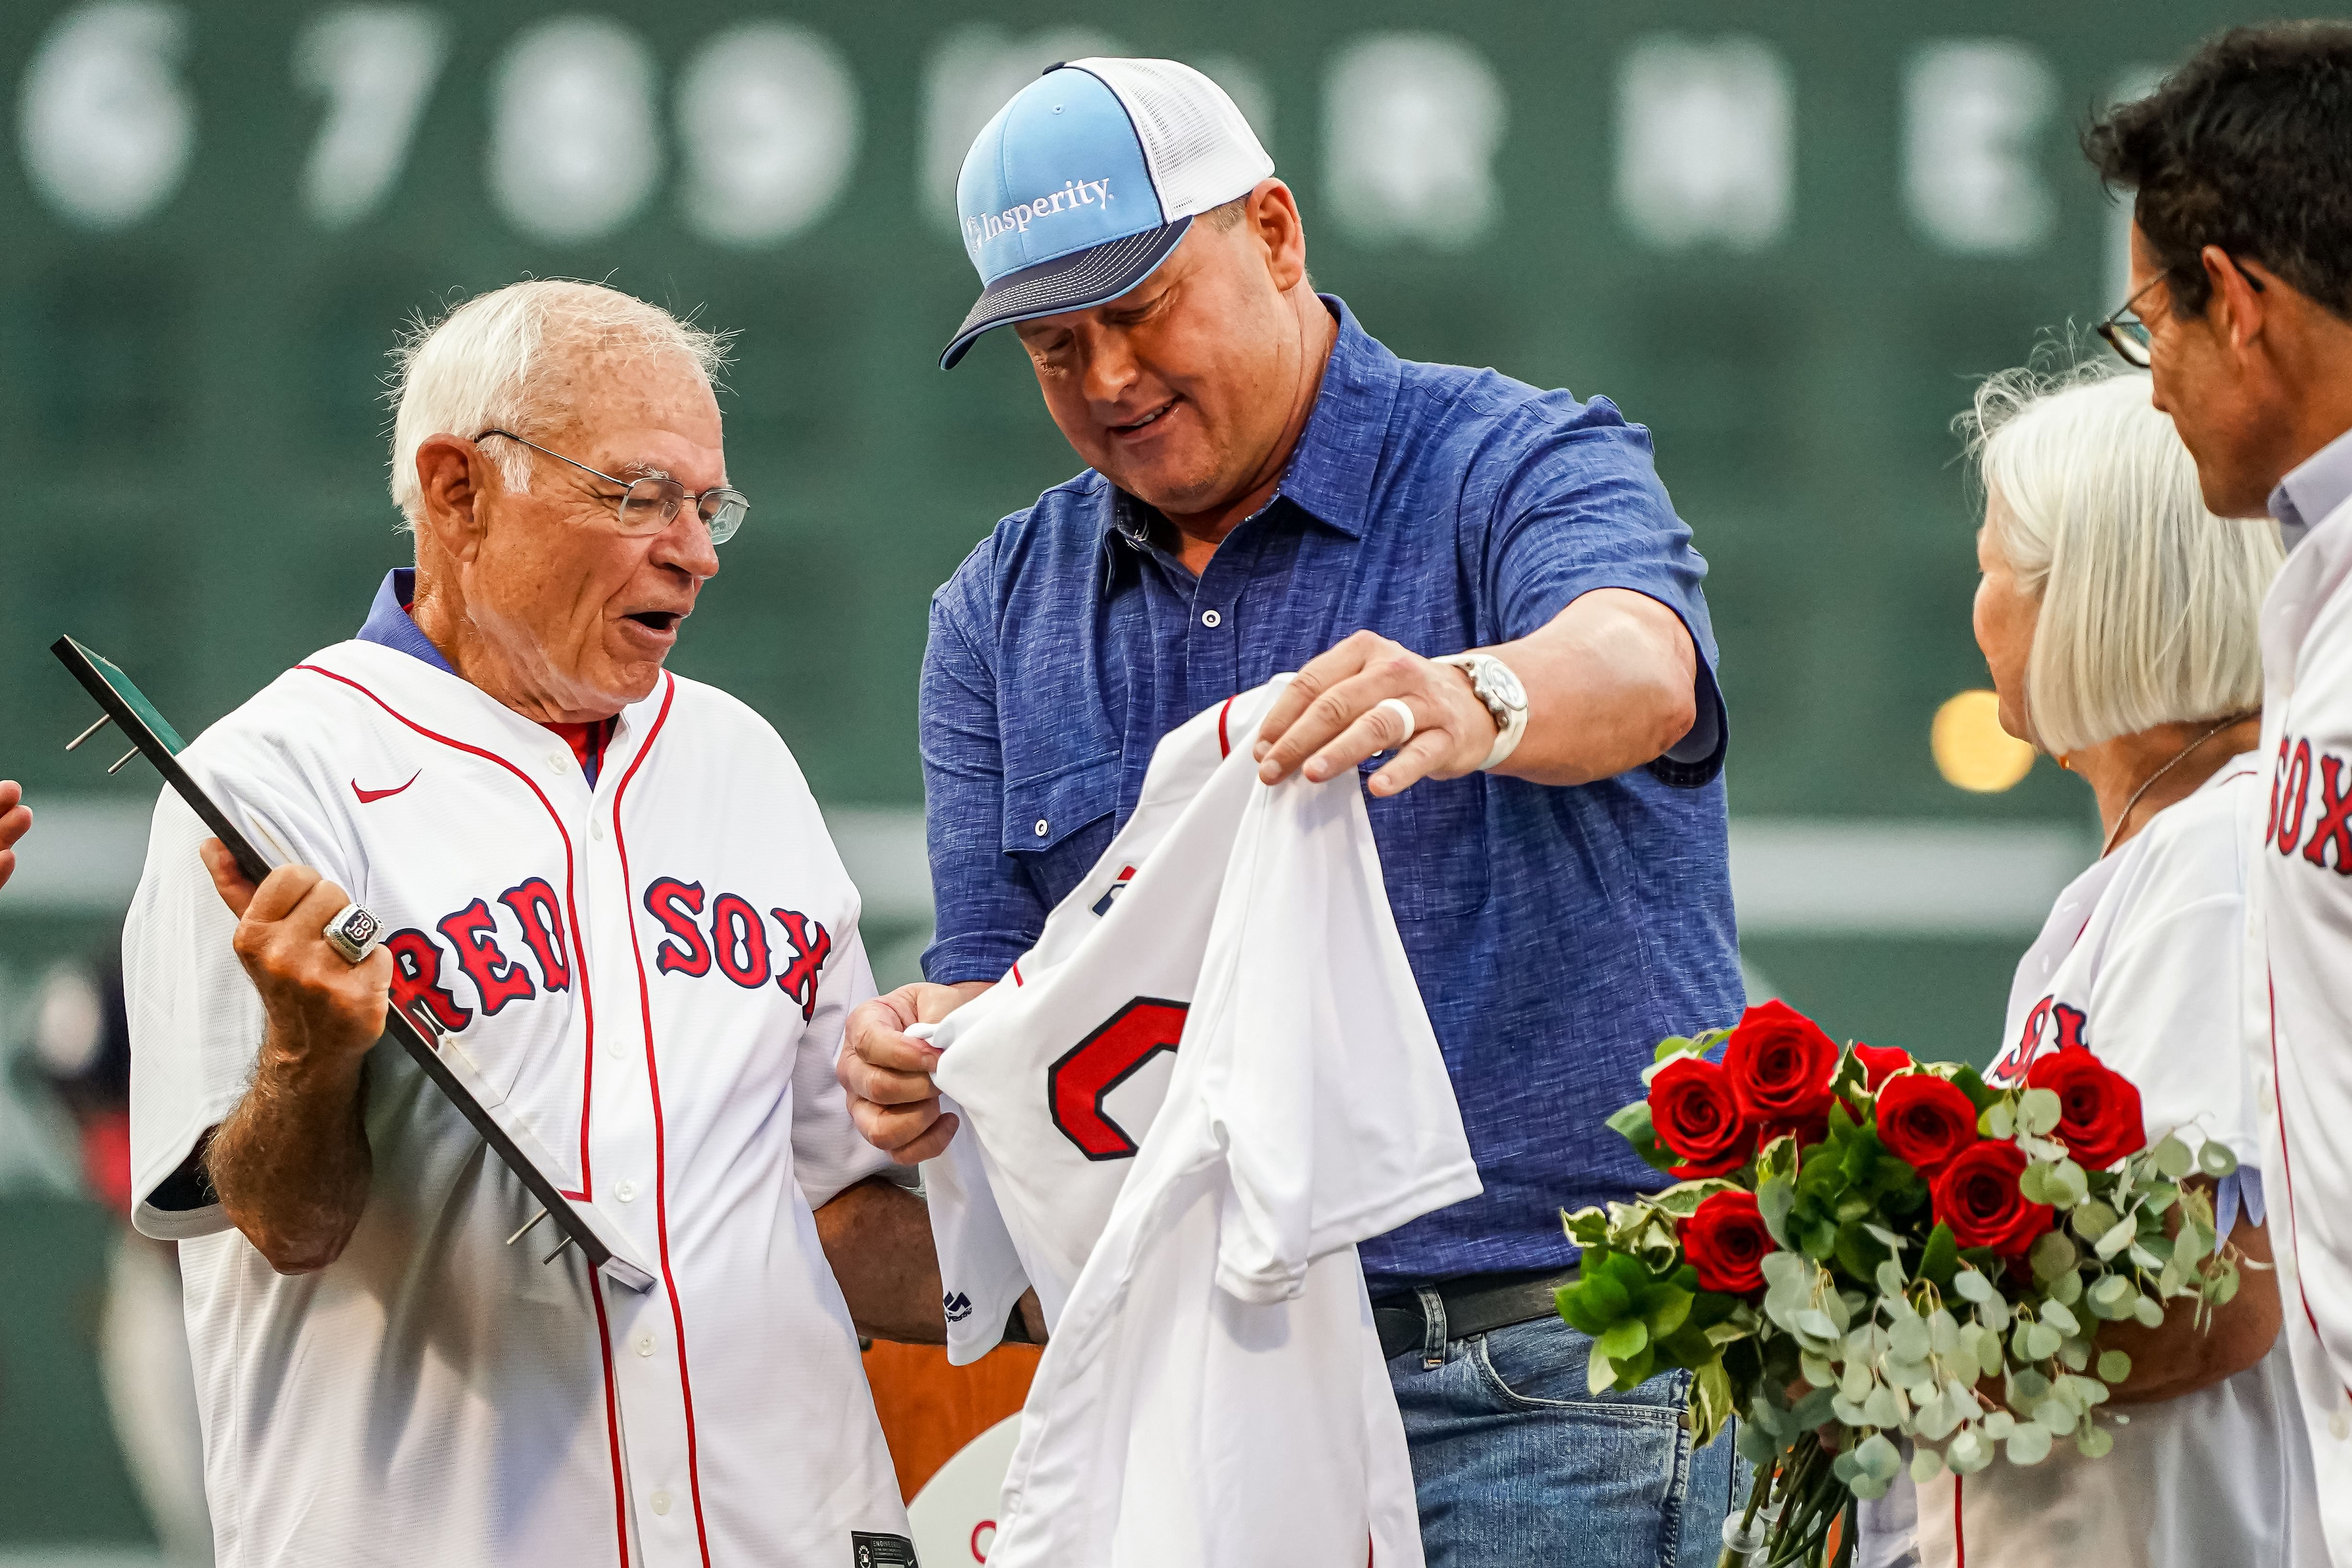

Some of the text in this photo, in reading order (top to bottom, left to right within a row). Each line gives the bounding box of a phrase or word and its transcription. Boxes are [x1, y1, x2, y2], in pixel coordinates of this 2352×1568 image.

[302, 4, 444, 223] 7
[494, 20, 658, 238] 8
[980, 178, 1110, 242] Insperity
[379, 876, 831, 1051] RED SOX
